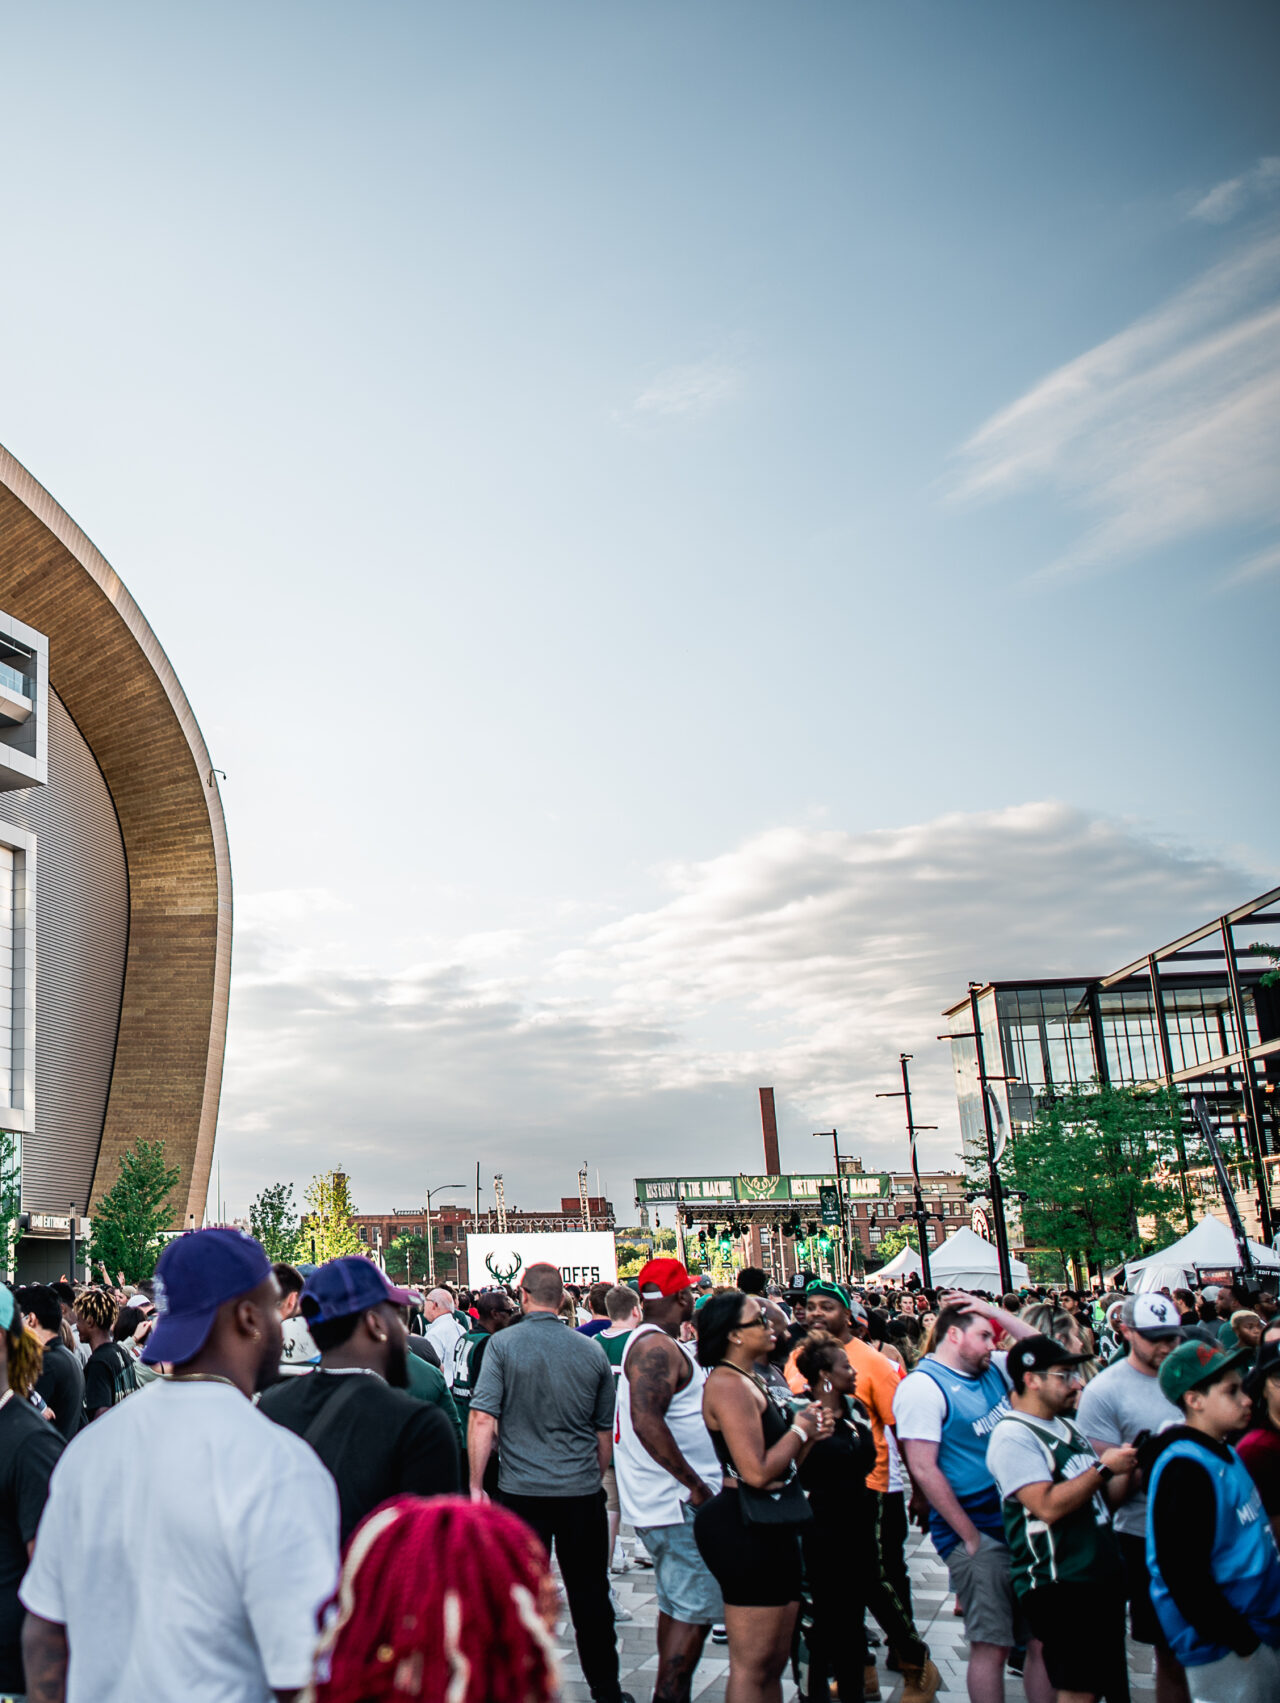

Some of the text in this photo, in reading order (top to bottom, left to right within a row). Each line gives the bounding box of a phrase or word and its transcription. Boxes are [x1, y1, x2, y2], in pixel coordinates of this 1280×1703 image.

[645, 1182, 676, 1199] HISTORY
[686, 1181, 701, 1197] THE
[702, 1180, 732, 1197] MAKING
[849, 1178, 880, 1195] MAKING
[44, 1215, 70, 1229] ENTRANCE
[558, 1266, 600, 1283] OFFS
